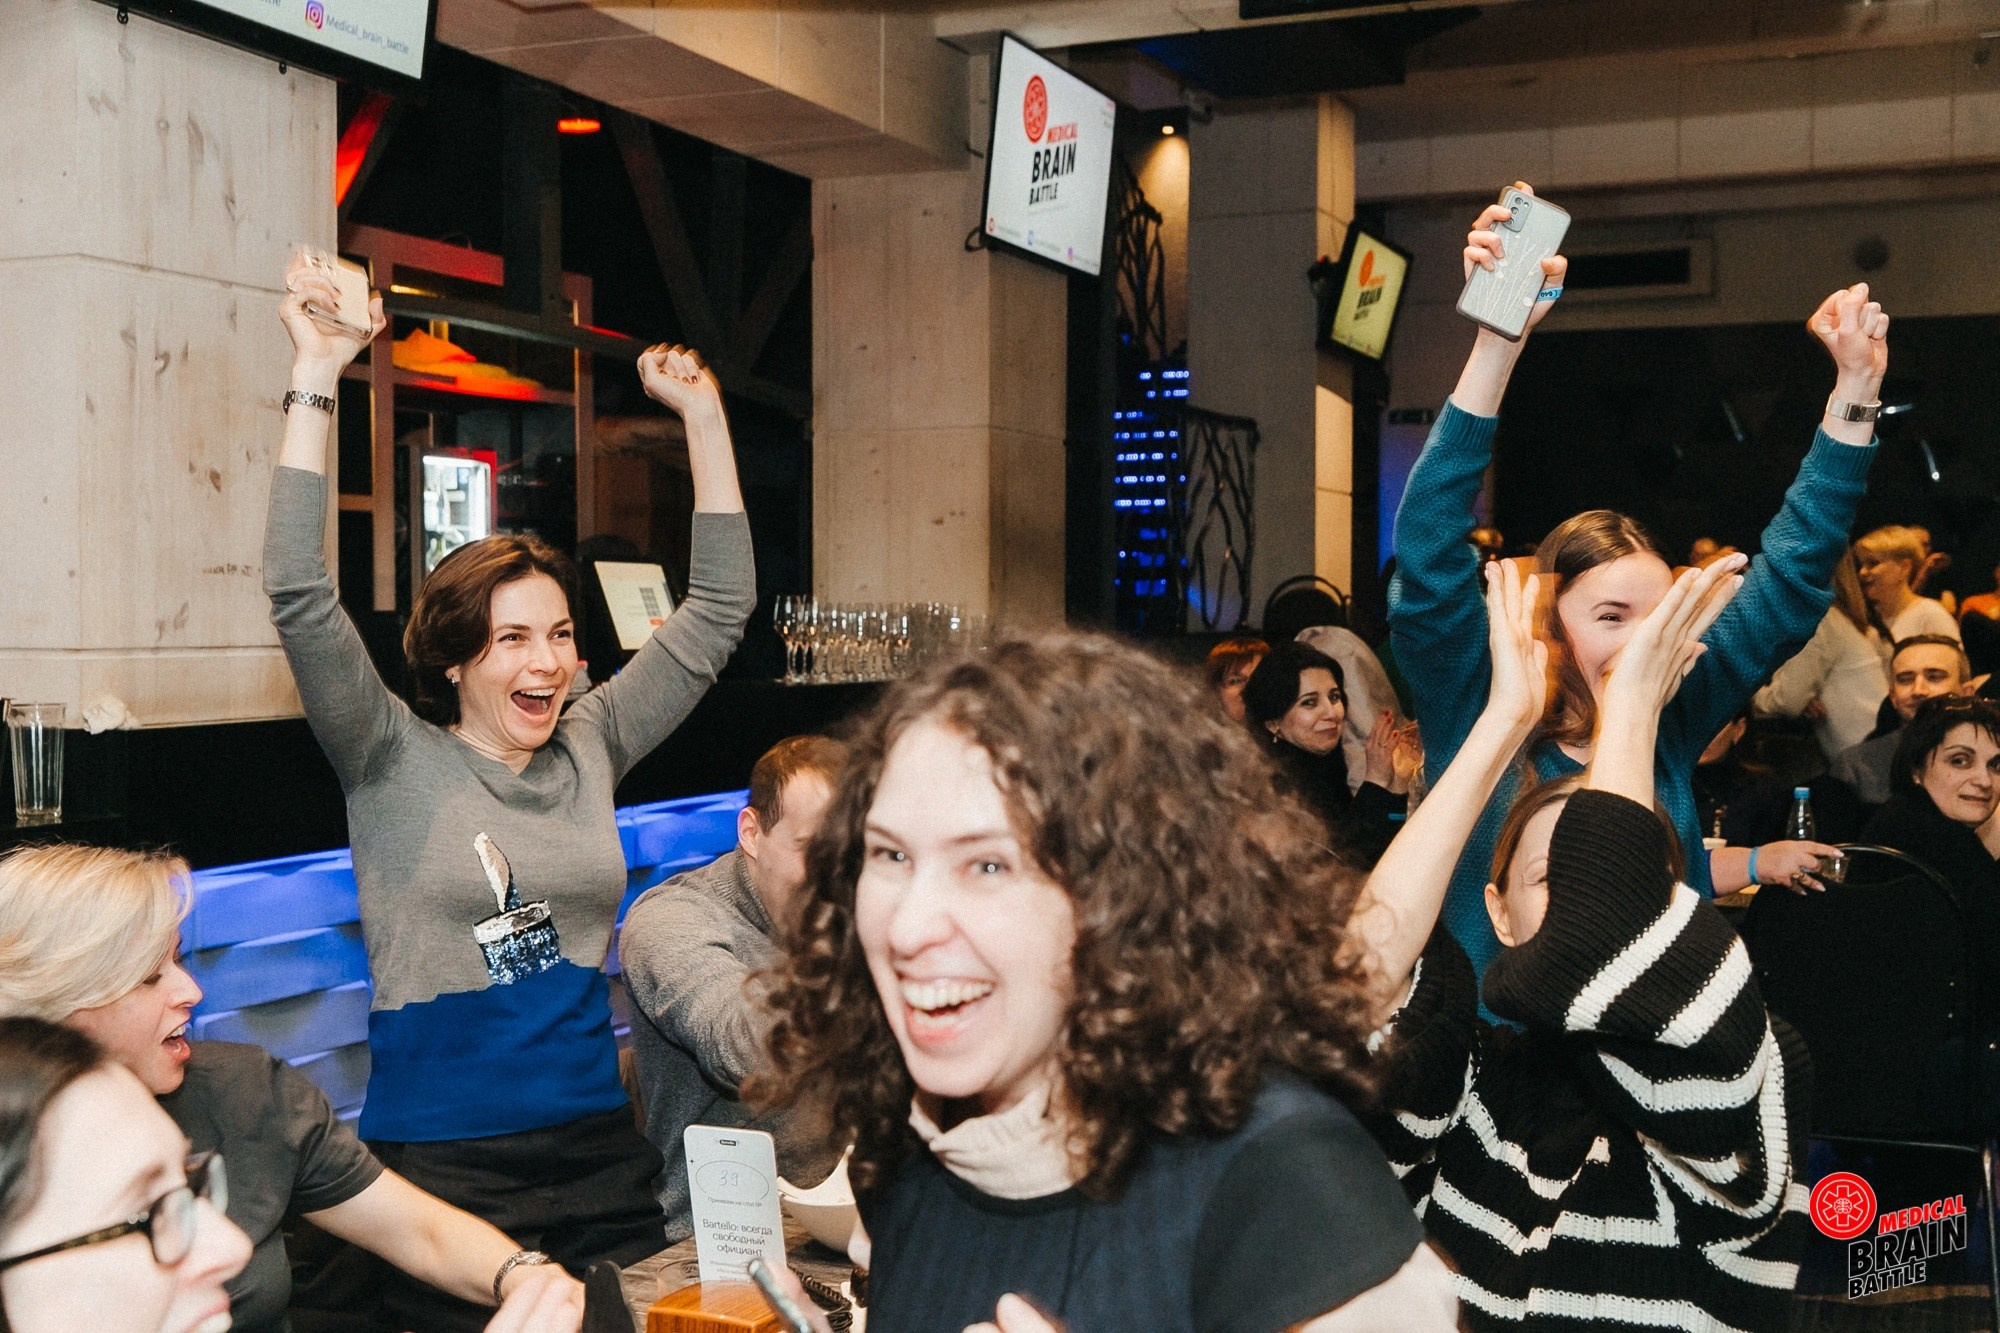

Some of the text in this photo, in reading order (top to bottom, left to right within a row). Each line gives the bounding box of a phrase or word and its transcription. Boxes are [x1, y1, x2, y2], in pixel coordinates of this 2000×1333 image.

[1031, 142, 1077, 183] BRAIN
[1029, 182, 1057, 205] BATTLE
[719, 1169, 738, 1187] 39
[741, 1224, 773, 1235] всегда
[712, 1232, 765, 1245] свободный
[716, 1243, 762, 1257] официант
